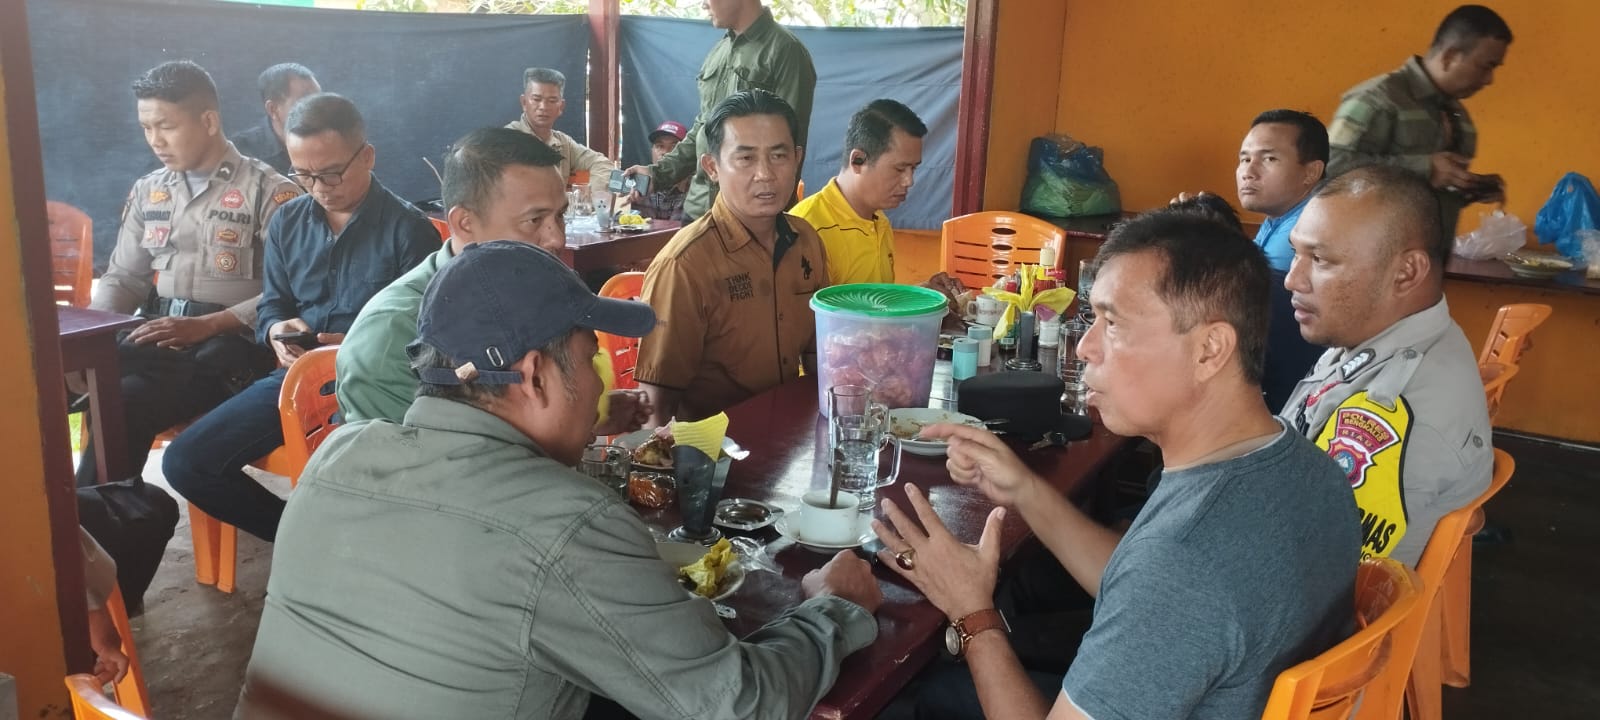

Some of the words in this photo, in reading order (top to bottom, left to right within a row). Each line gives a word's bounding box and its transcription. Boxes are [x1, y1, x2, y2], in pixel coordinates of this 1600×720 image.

[208, 209, 251, 225] POLRI
[724, 271, 752, 284] THINK
[1342, 411, 1390, 441] POLRES
[1343, 418, 1385, 442] BENGKALIS
[1341, 428, 1374, 448] RIAU
